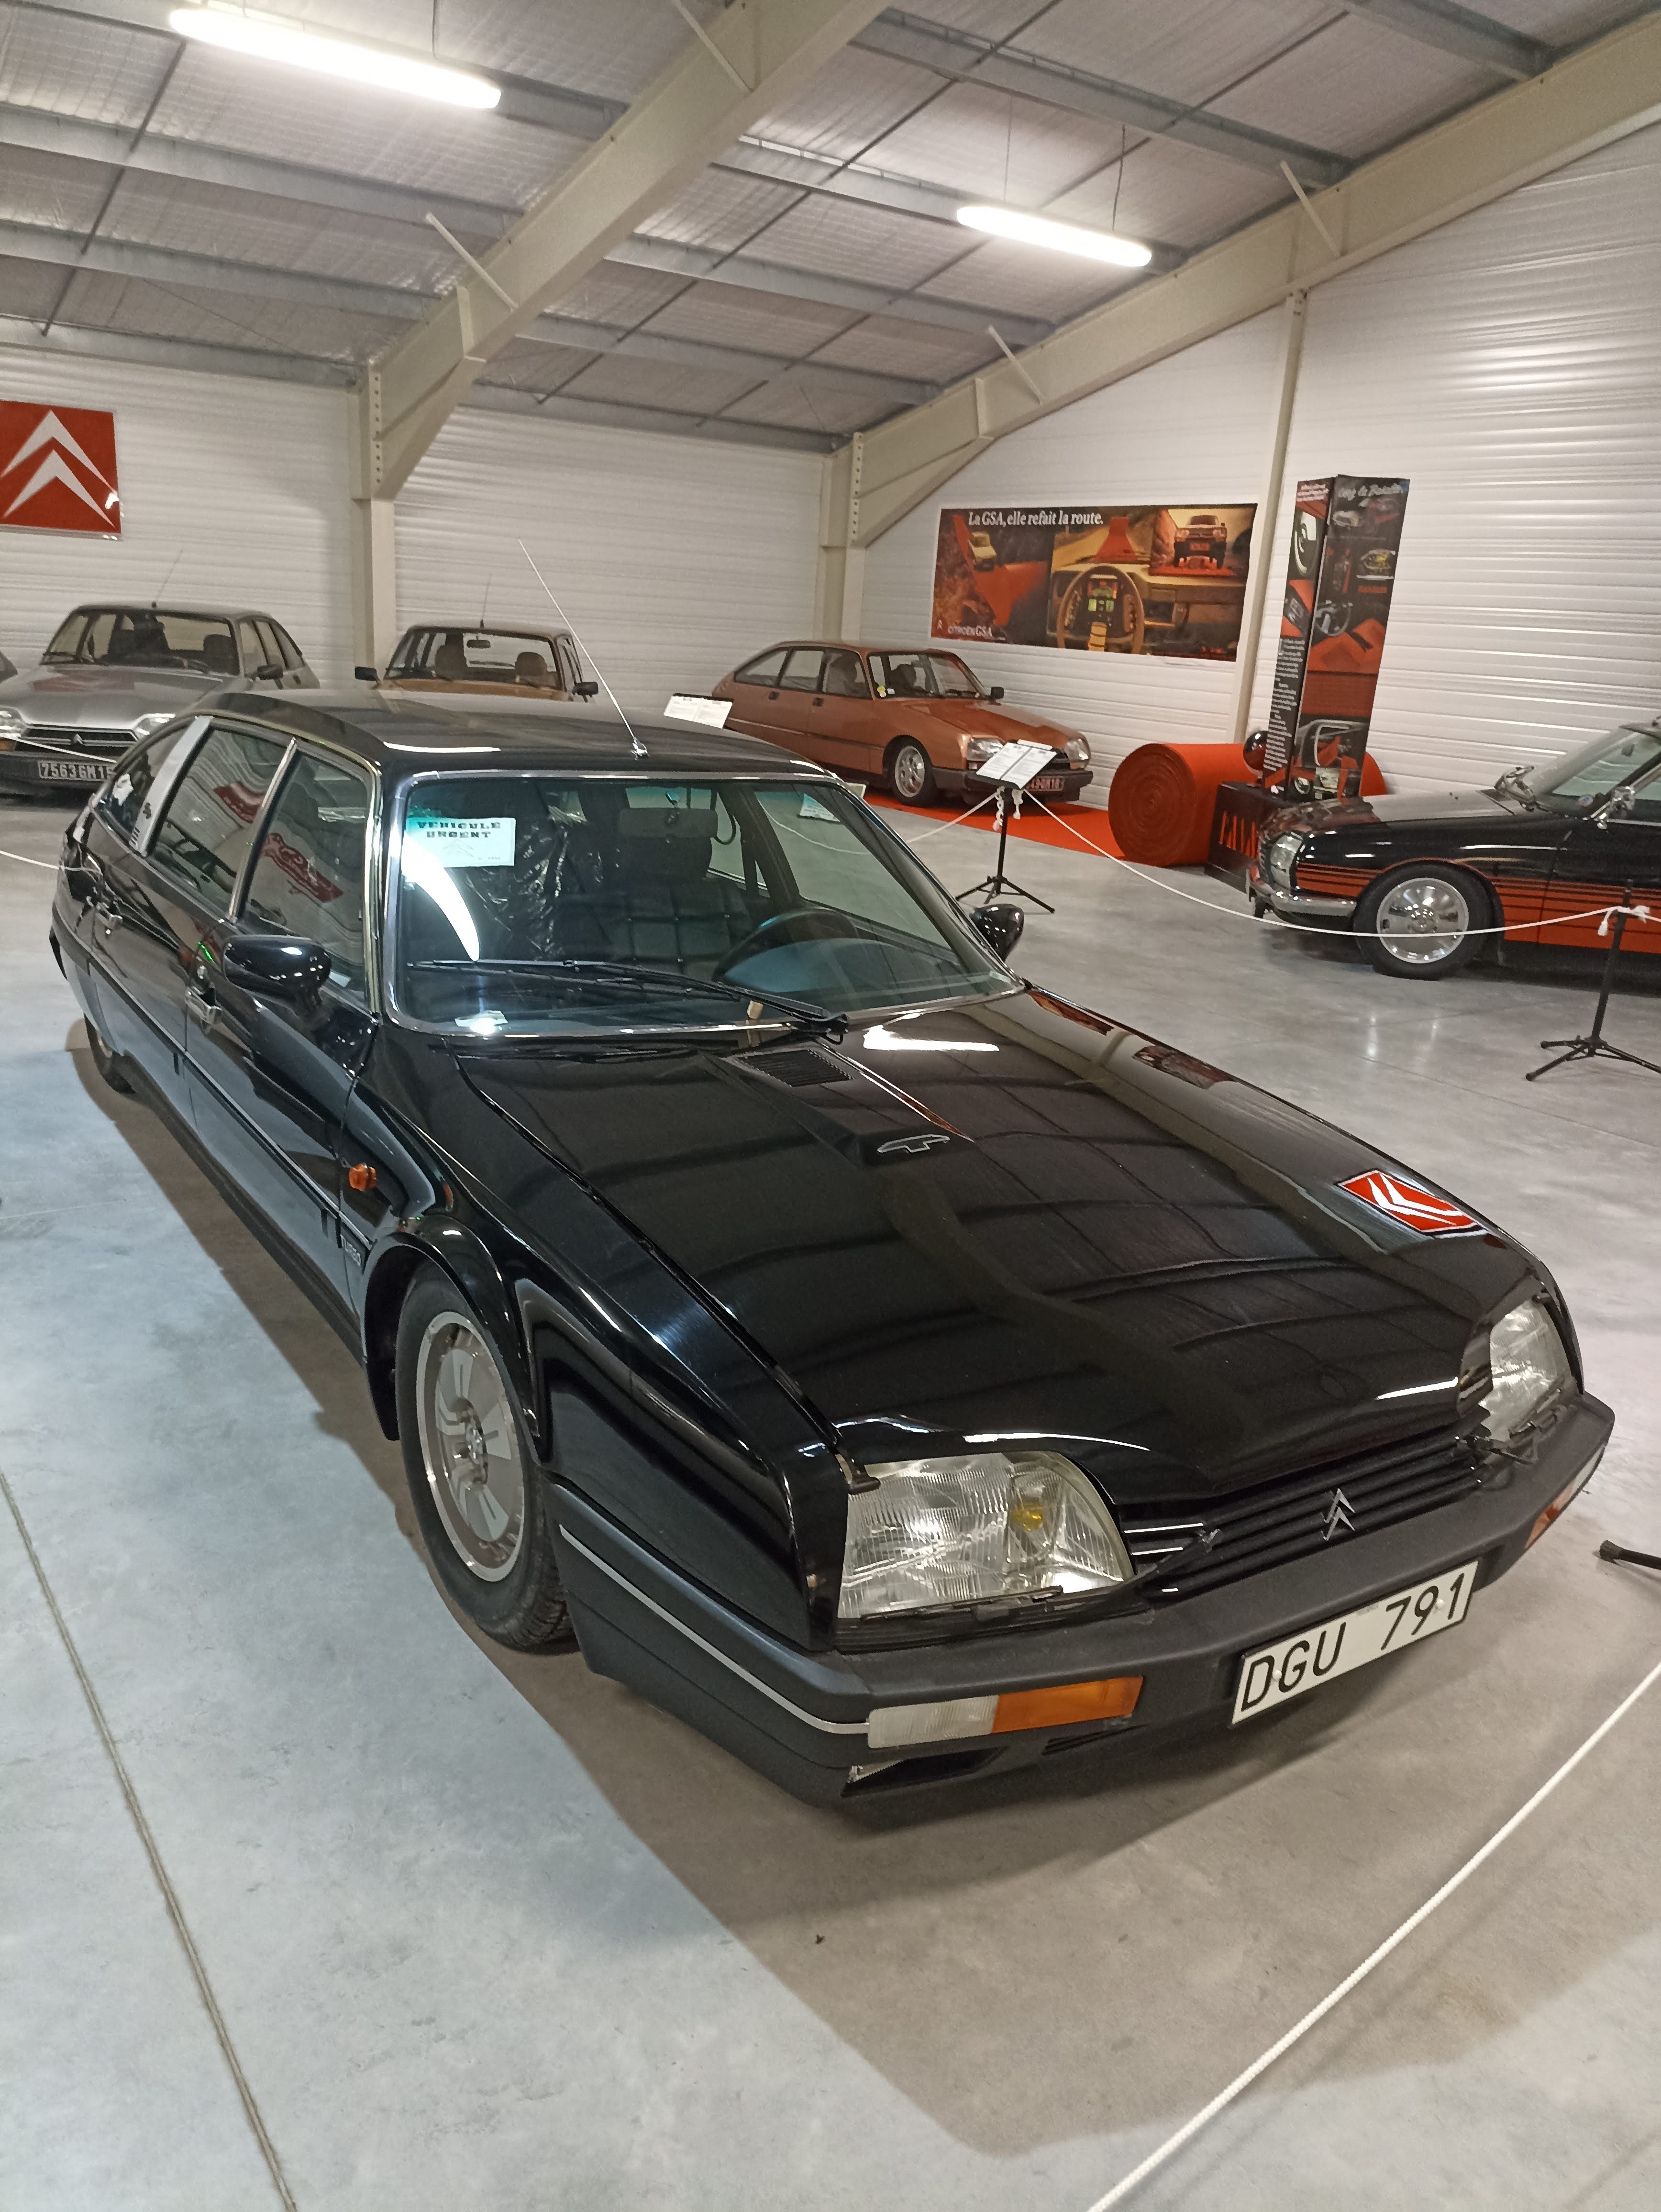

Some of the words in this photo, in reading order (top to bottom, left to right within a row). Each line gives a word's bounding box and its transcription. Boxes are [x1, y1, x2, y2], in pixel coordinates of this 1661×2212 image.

[969, 511, 980, 525] La
[982, 511, 1006, 527] GSA,
[1007, 511, 1026, 525] elle
[1028, 510, 1056, 525] refait
[1059, 510, 1068, 525] la
[1070, 512, 1103, 525] route.
[975, 625, 993, 638] GSA
[1241, 1622, 1346, 1712] DGU
[1381, 1573, 1465, 1650] 791
